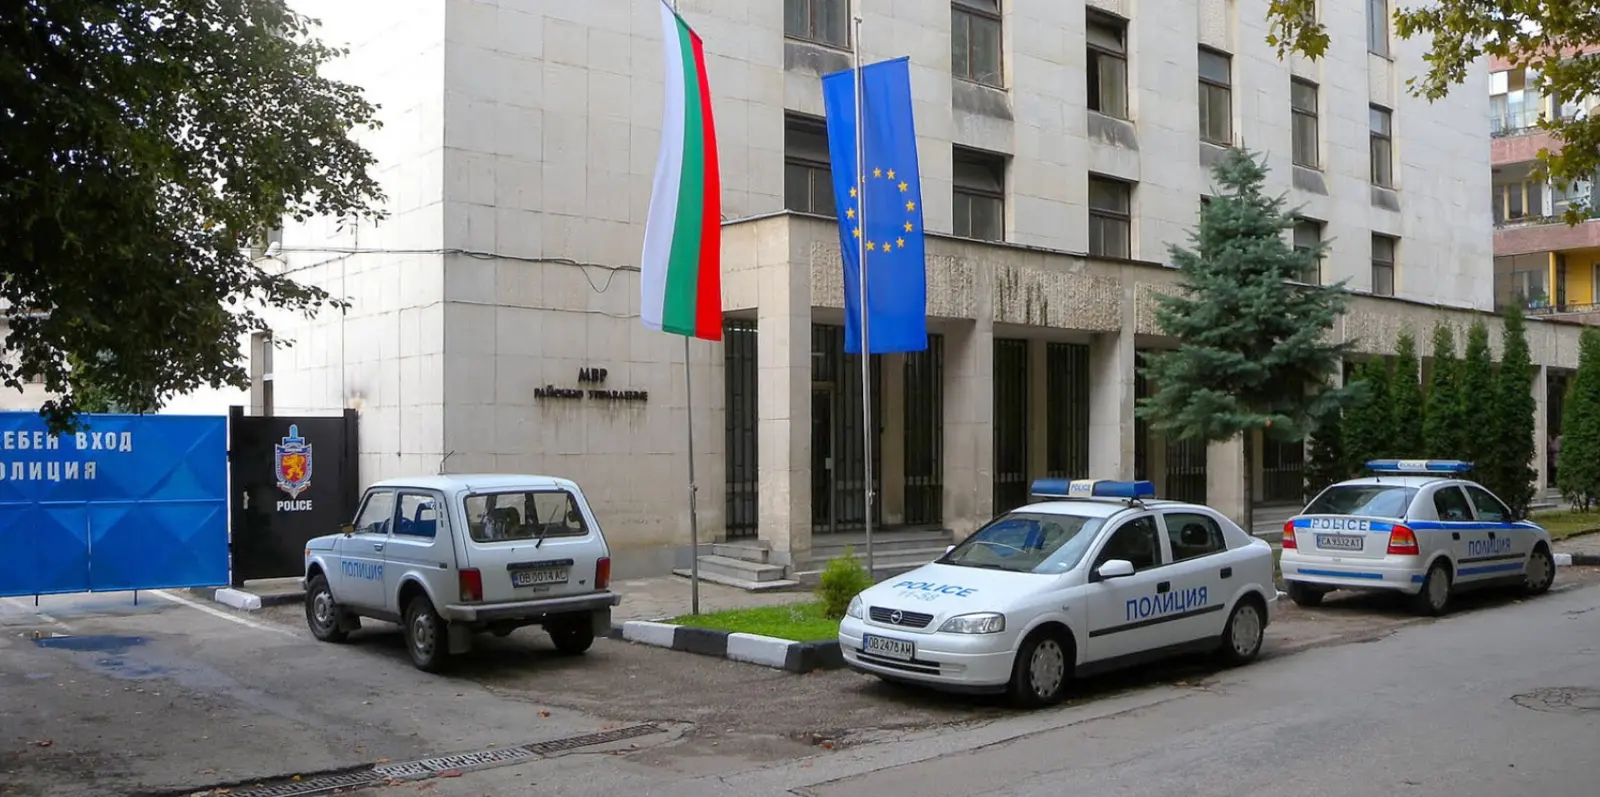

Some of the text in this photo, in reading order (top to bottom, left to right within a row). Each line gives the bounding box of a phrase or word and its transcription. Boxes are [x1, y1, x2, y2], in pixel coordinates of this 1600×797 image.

[578, 367, 608, 382] МВР
[0, 431, 132, 452] ЕБЕН ВХОД
[1071, 483, 1091, 492] POLICE
[276, 500, 313, 511] POLICE
[1312, 518, 1368, 531] POLICE
[1468, 537, 1511, 557] ПОЛИЦИЯ
[341, 561, 383, 580] ПОЛИЦИЯ
[892, 581, 979, 597] POLICE
[1126, 586, 1207, 620] ПОЛИЦИЯ
